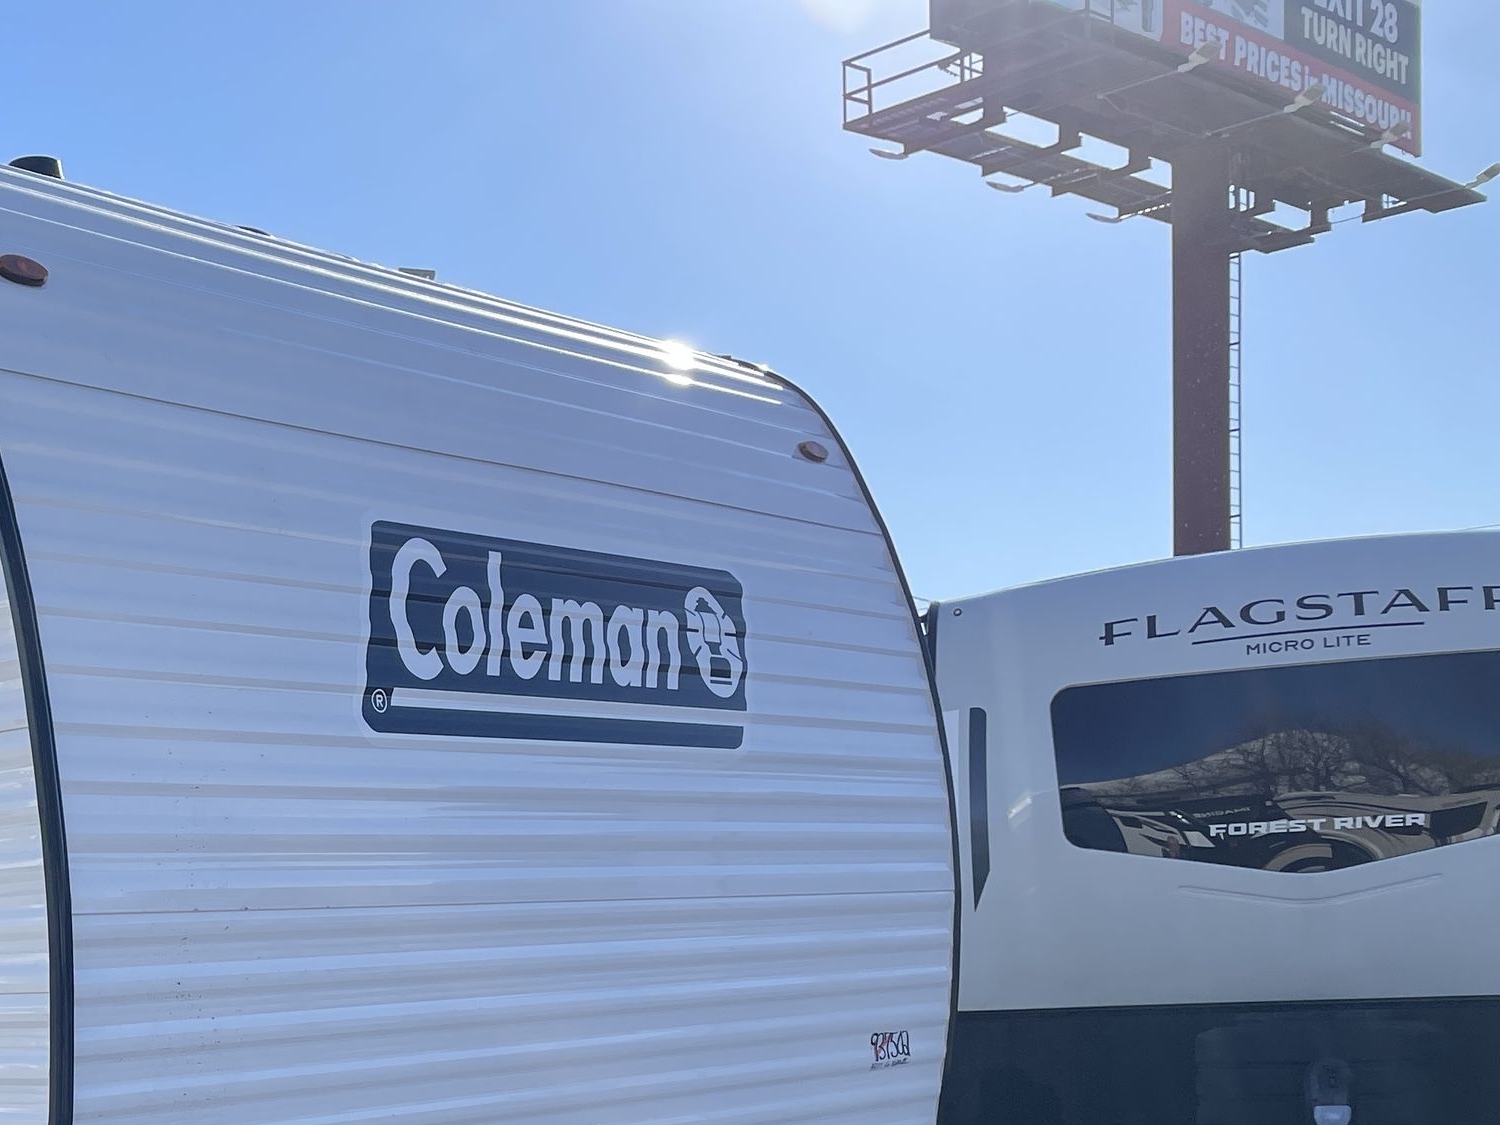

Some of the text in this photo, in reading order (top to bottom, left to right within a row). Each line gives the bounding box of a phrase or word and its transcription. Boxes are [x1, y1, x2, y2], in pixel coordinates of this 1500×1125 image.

[1301, 6, 1408, 84] TURN RIGHT
[1370, 0, 1398, 43] 28
[1234, 35, 1303, 92] PRICES
[389, 537, 682, 690] Coleman
[1246, 634, 1371, 656] MICRO LITE
[1209, 813, 1425, 838] FOREST RIVER
